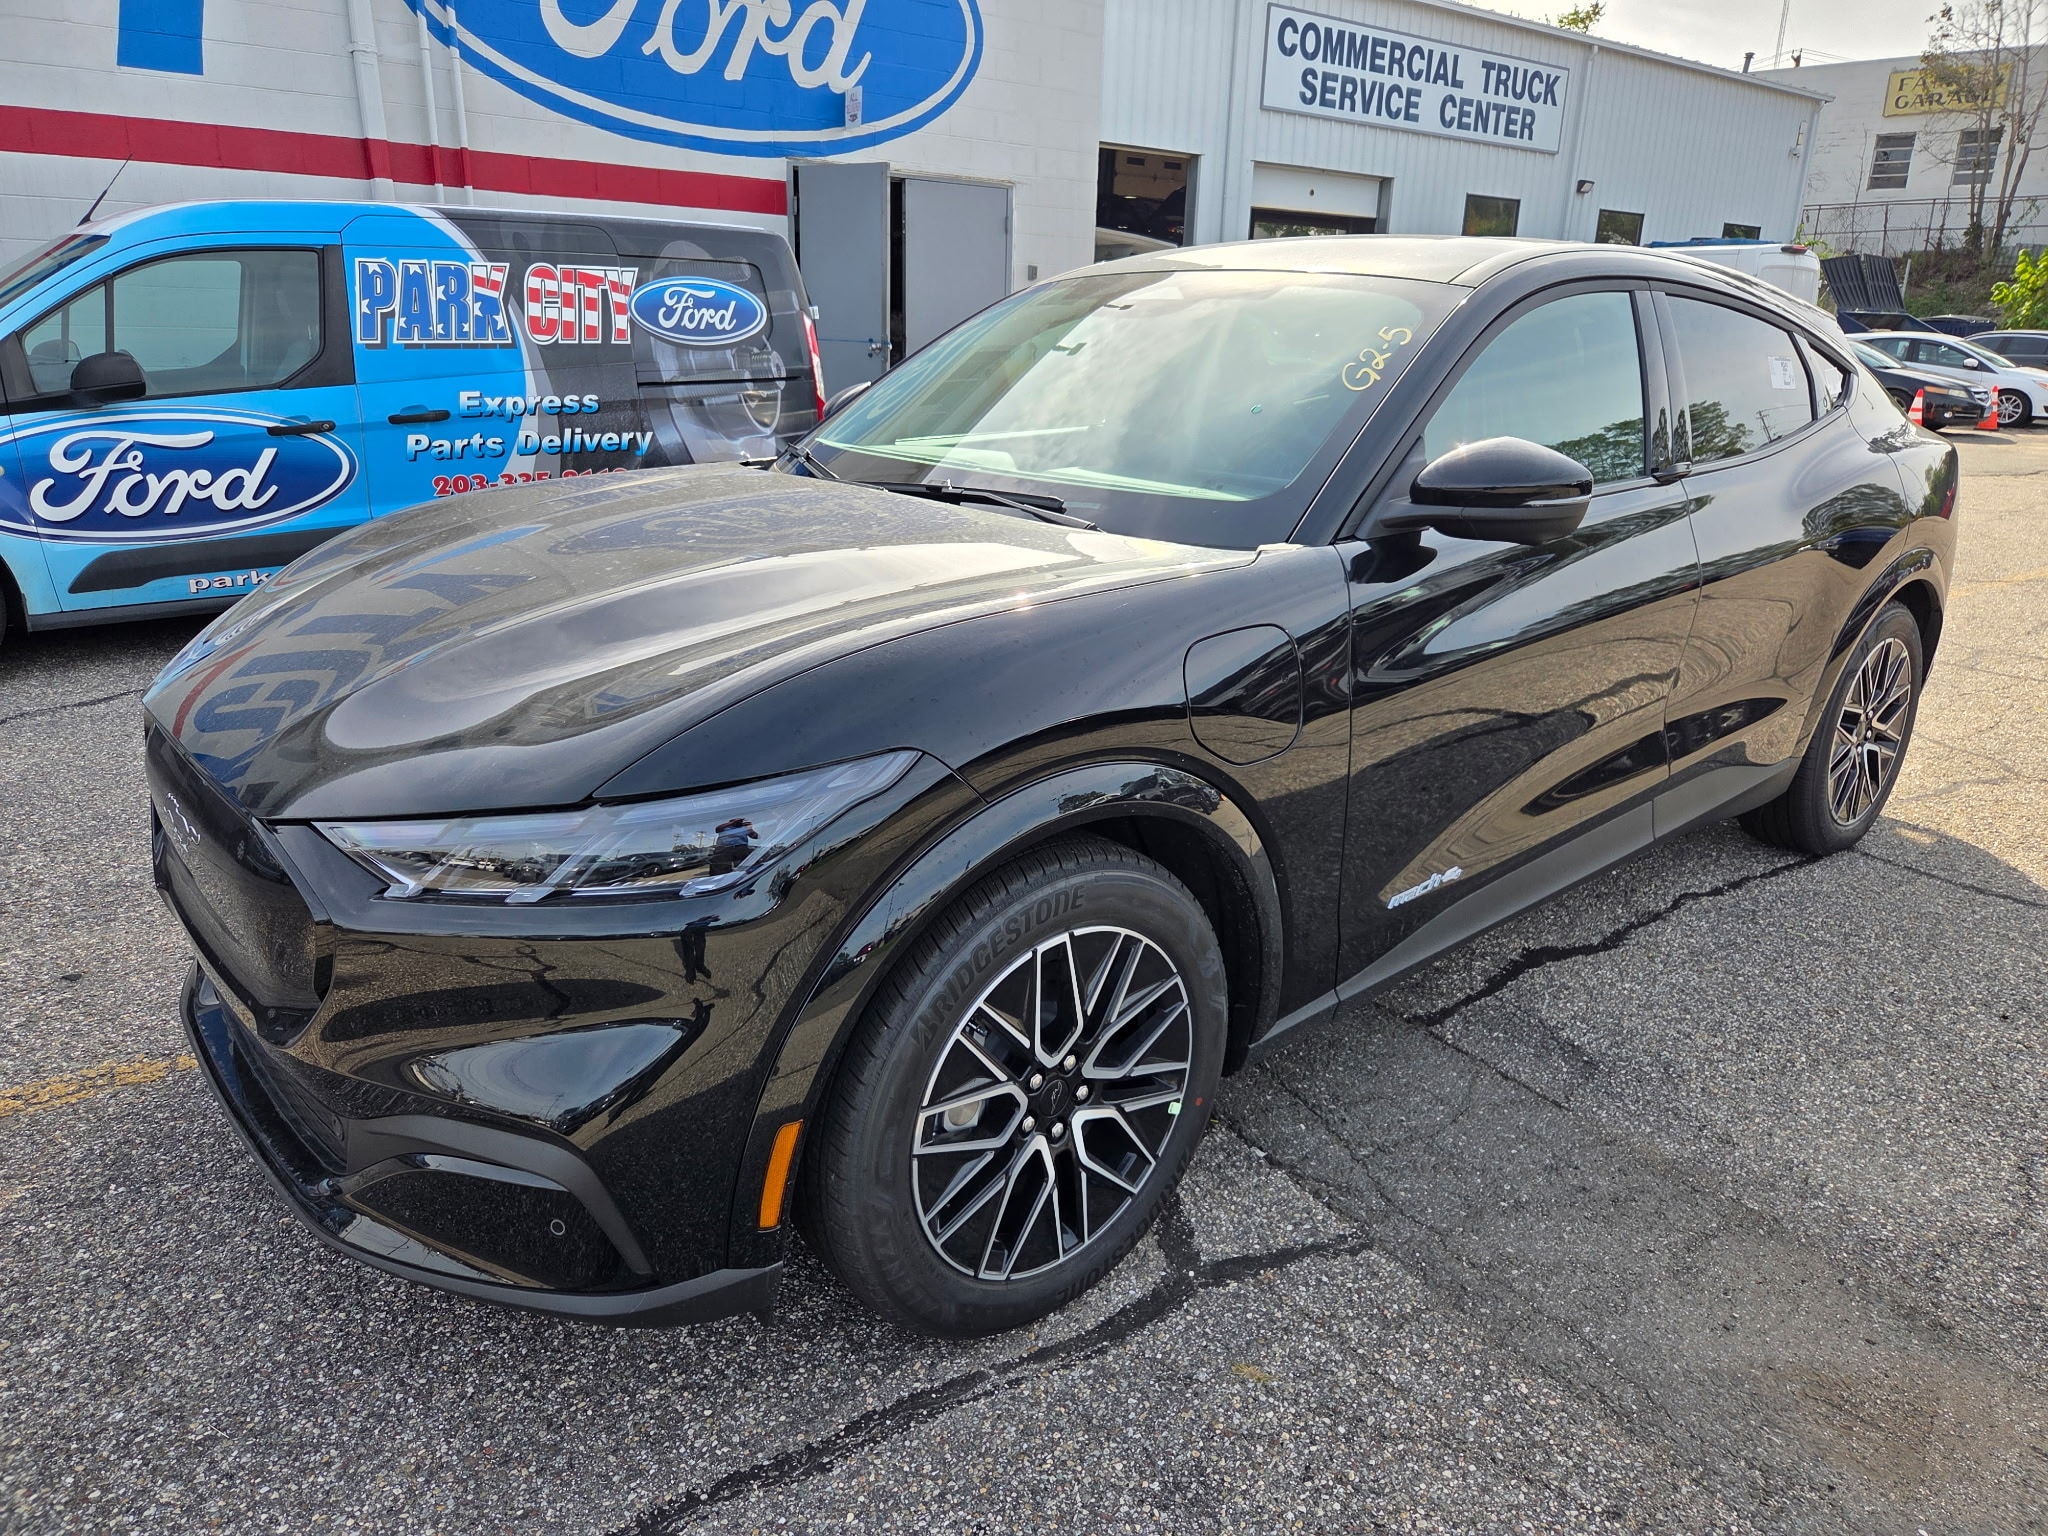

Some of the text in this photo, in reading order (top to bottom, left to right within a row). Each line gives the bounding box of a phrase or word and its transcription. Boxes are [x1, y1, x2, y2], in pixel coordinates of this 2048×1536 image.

[540, 0, 872, 94] ord
[1277, 17, 1562, 107] COMMERCIAL TRUCK
[1299, 67, 1537, 141] SERVICE CENTER
[354, 257, 737, 345] PARK CITY Ford
[406, 427, 654, 461] Parts Delivery
[458, 391, 600, 422] Express
[30, 430, 279, 522] Ford
[911, 884, 1087, 1053] BRIDGESTONE
